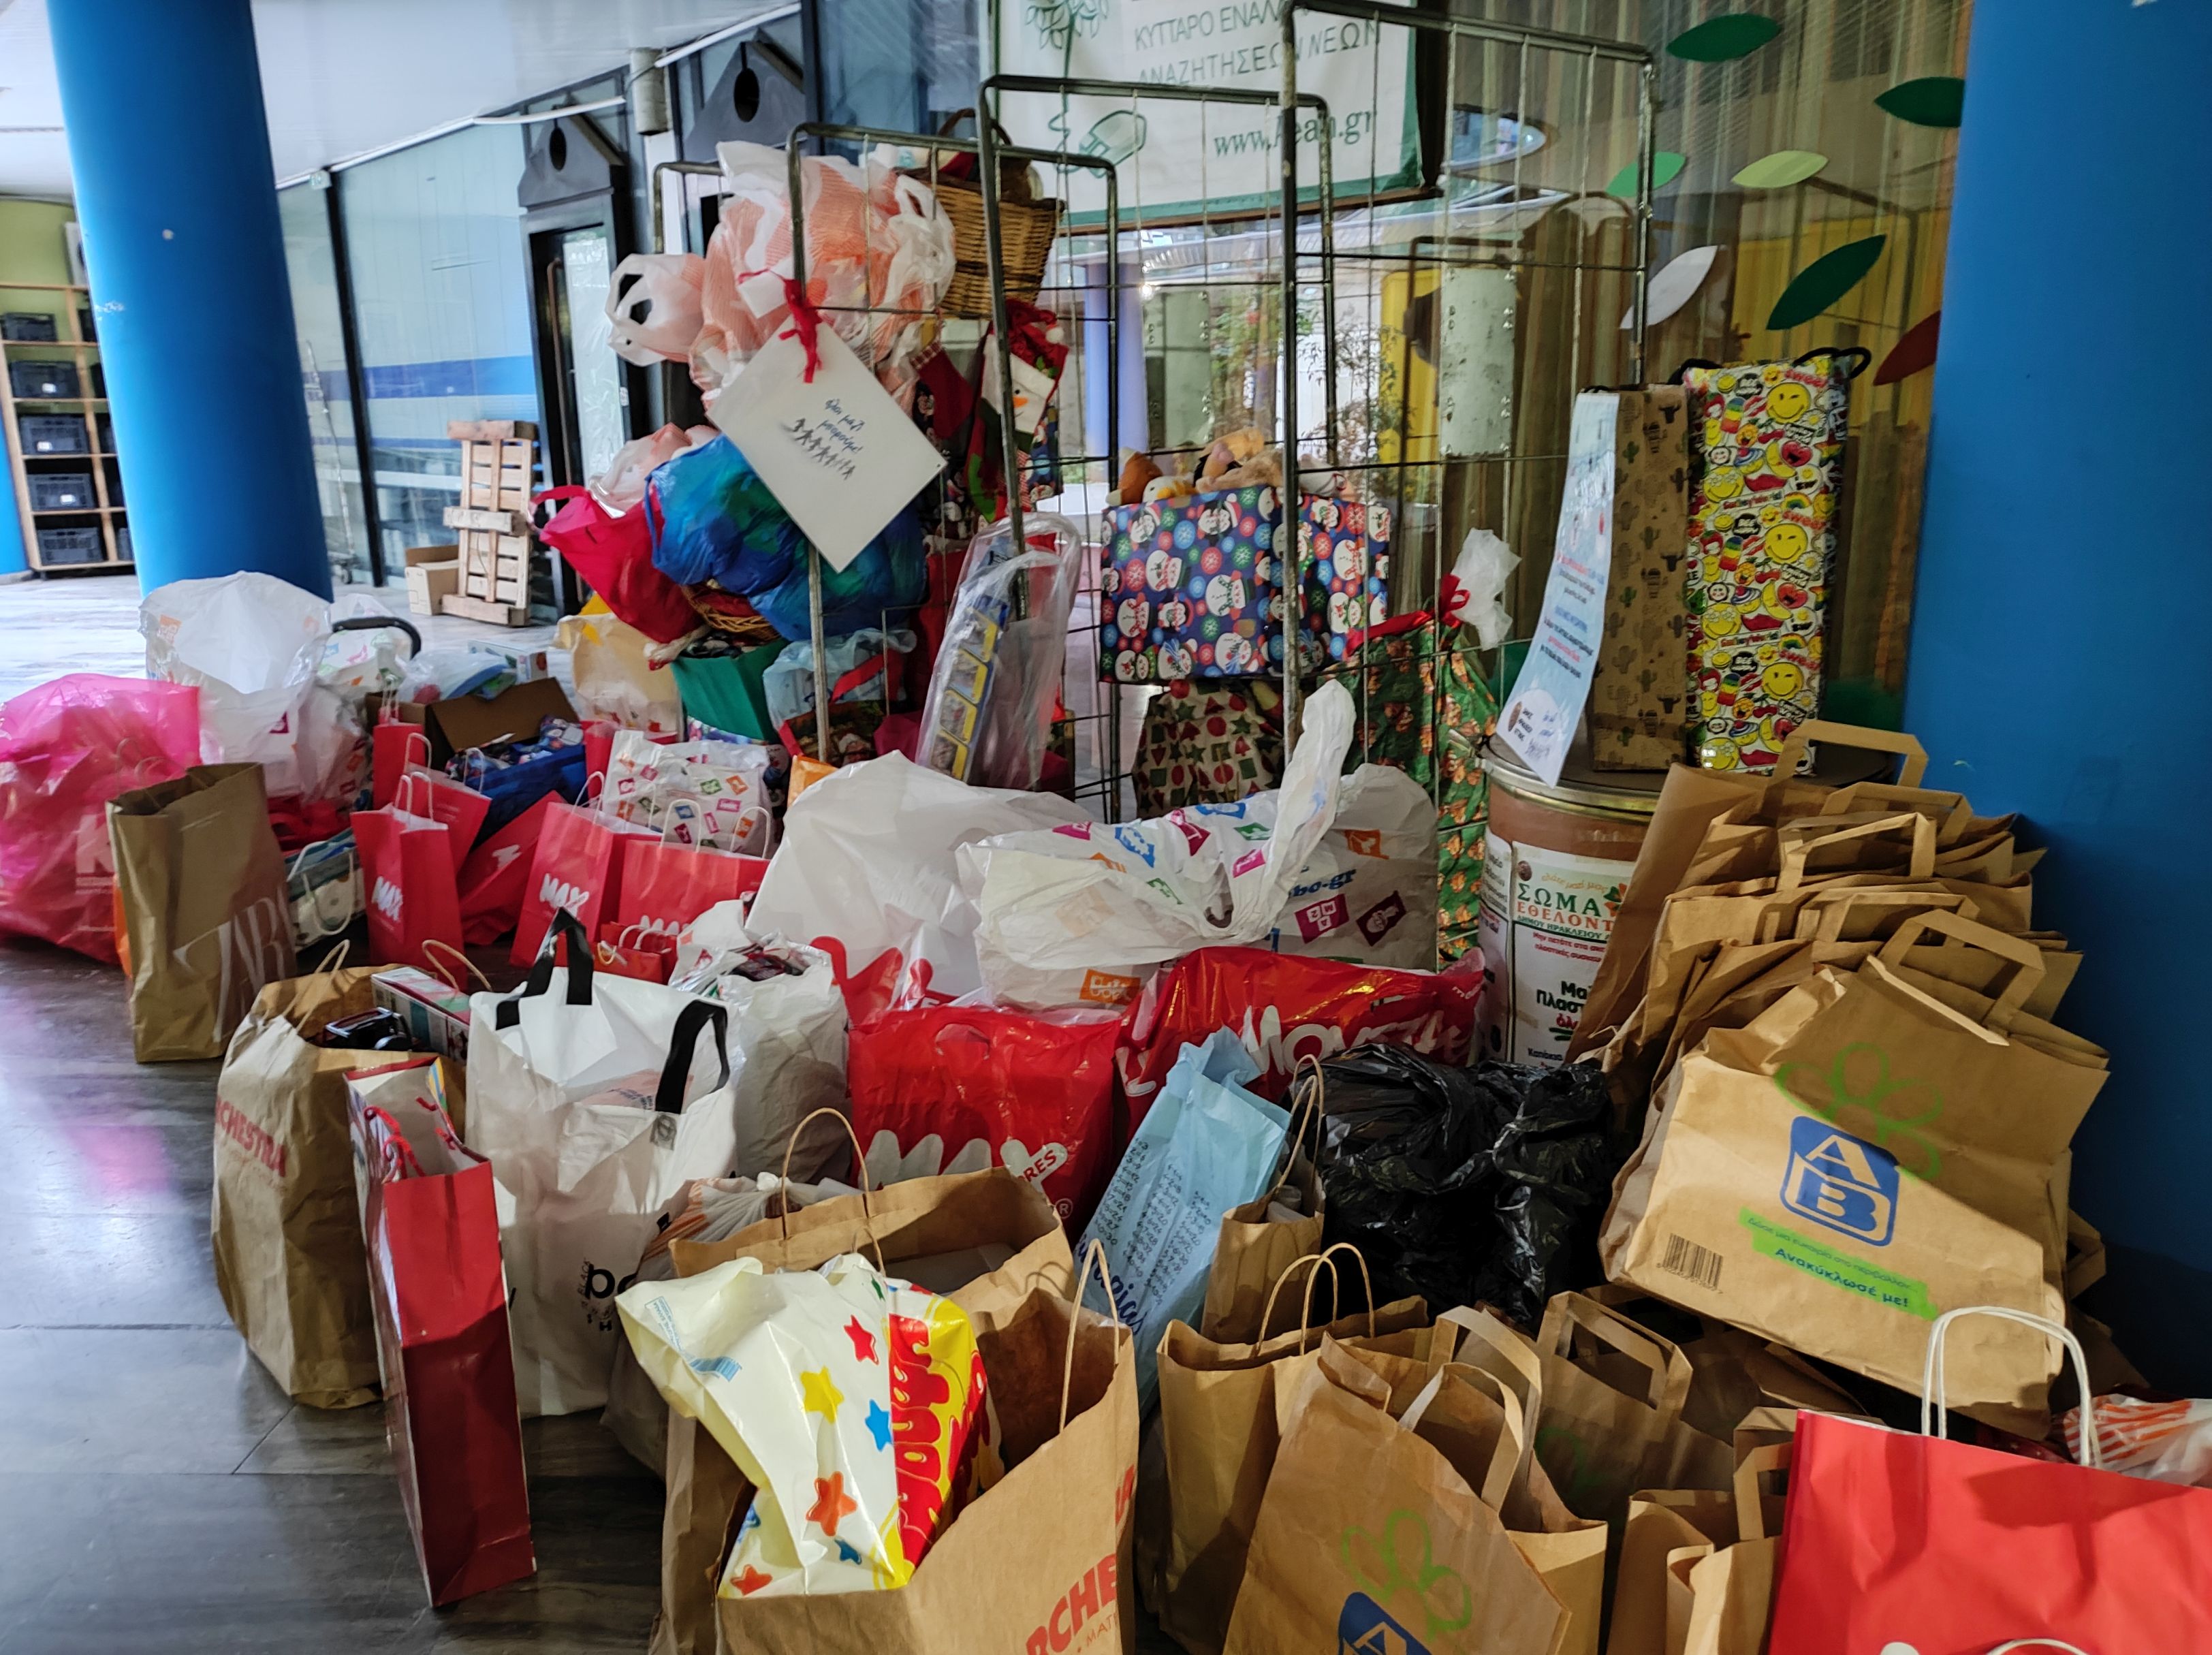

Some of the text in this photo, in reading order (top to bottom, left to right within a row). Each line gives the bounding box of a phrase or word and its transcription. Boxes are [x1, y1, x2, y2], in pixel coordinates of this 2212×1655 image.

[1134, 10, 1214, 51] ΚΥΤΤΑΡΟ
[1517, 883, 1602, 917] ΣΩΜΑ
[1517, 901, 1614, 932] ΕΘΕΛΟΝΤ
[1020, 1148, 1058, 1183] RES
[1775, 1248, 1909, 1308] Ανακύκλωσέ με!
